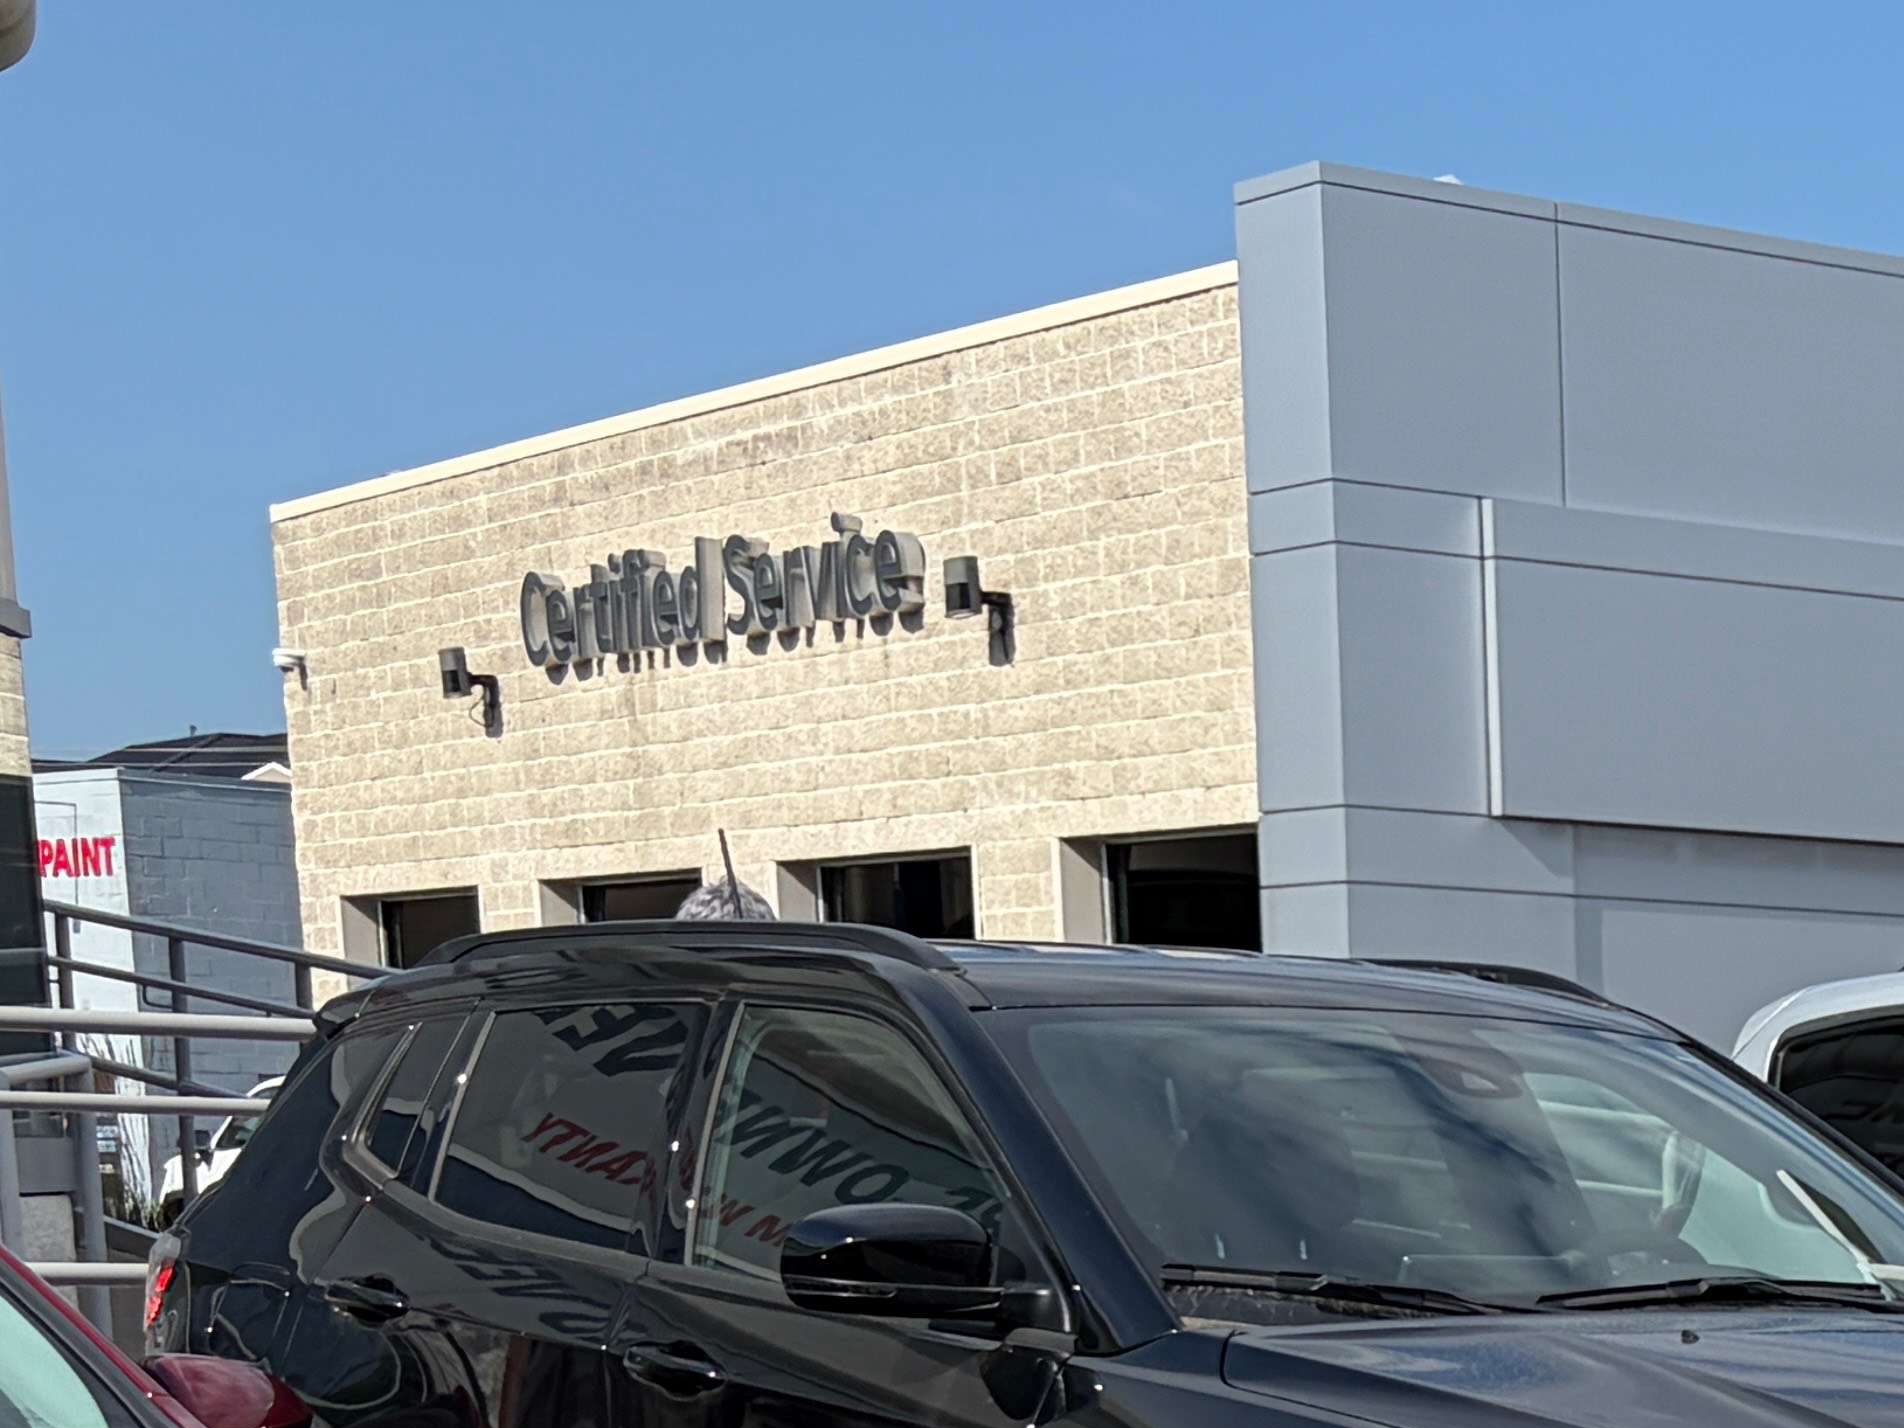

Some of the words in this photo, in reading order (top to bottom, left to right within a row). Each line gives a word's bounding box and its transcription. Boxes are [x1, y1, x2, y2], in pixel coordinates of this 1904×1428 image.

[520, 537, 724, 667] Certified
[724, 512, 926, 636] Service
[36, 836, 116, 878] PAINT
